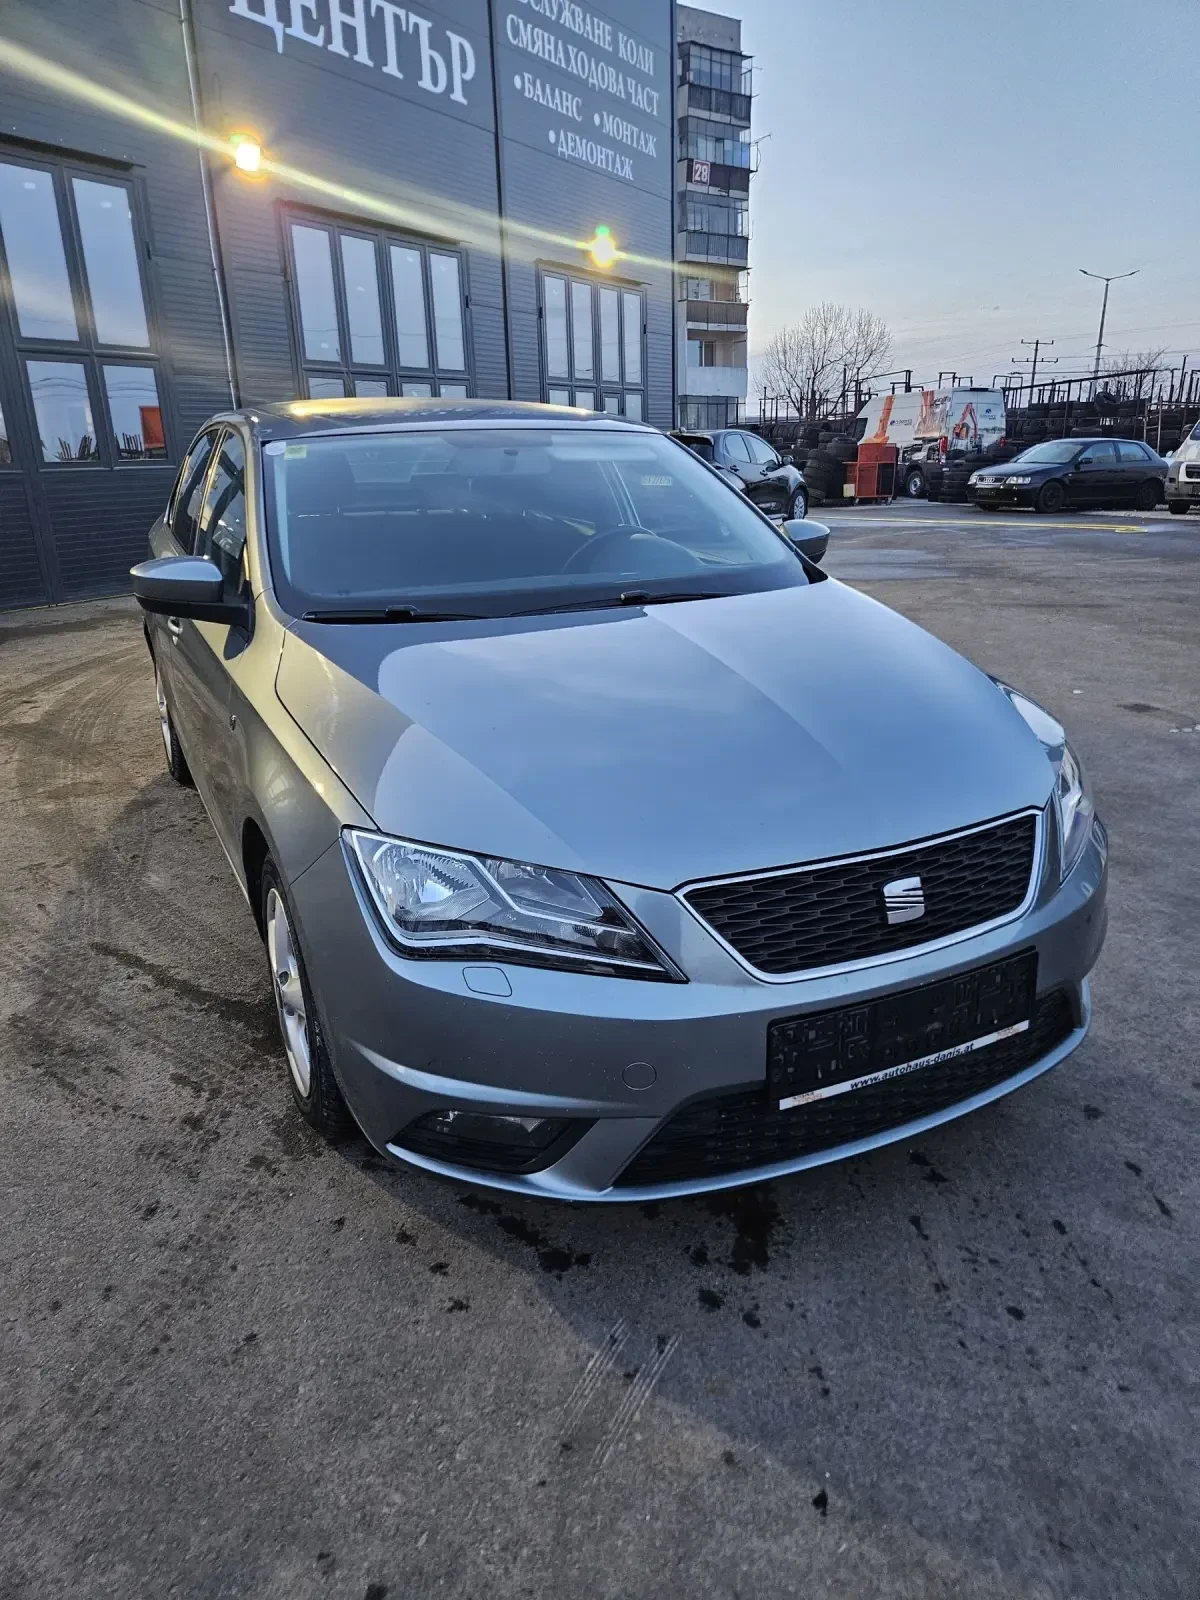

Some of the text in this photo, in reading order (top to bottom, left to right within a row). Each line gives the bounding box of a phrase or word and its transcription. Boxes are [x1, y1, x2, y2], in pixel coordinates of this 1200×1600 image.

[518, 0, 655, 77] ЛУЖВАНЕ КОЛИ
[506, 13, 660, 117] СМЯНА ХОДОВА ЧАСТ
[523, 72, 584, 122] БАЛАНС
[557, 129, 635, 181] ДЕМОНТАЖ
[601, 111, 657, 159] МОНТАЖ
[694, 163, 709, 183] 28
[849, 1041, 975, 1091] www.autohaus-danis.at
